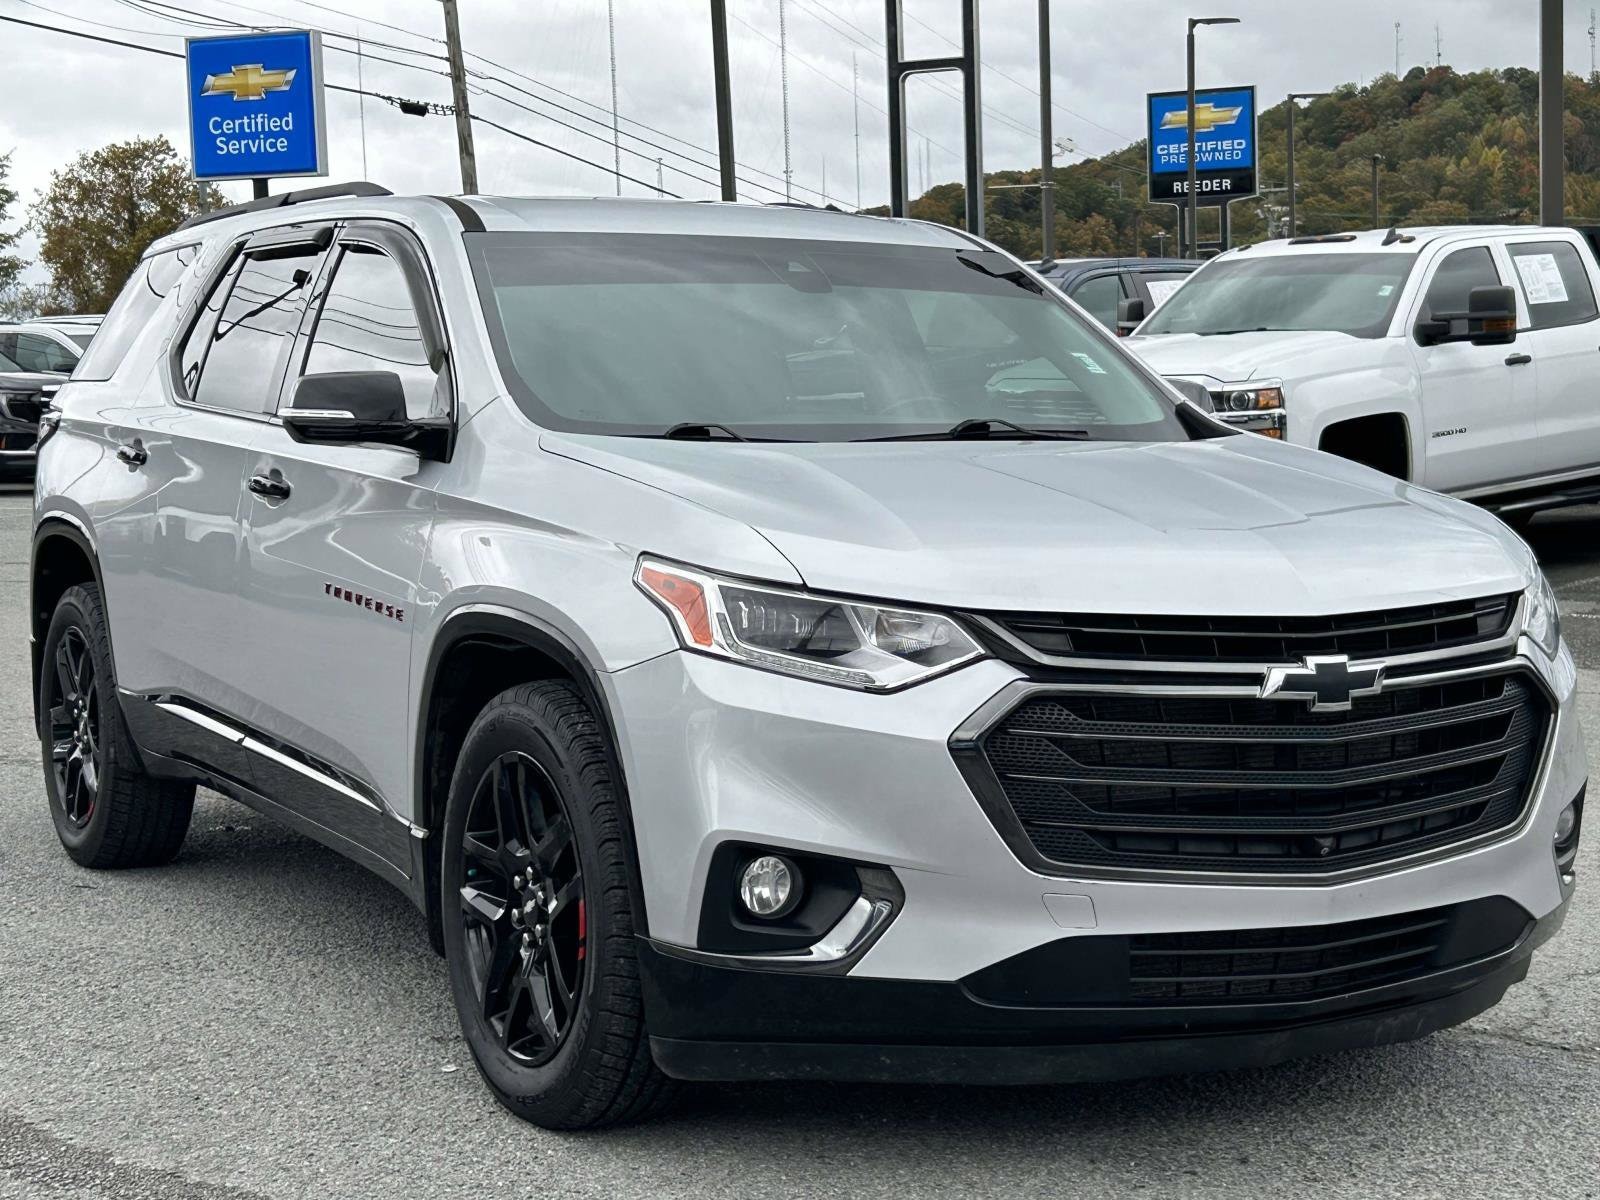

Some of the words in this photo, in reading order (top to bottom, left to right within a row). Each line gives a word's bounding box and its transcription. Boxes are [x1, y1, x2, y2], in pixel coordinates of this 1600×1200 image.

[209, 112, 293, 134] Certified
[216, 134, 288, 154] Service
[1173, 179, 1231, 193] REEDER
[324, 582, 404, 622] TRAVERSE
